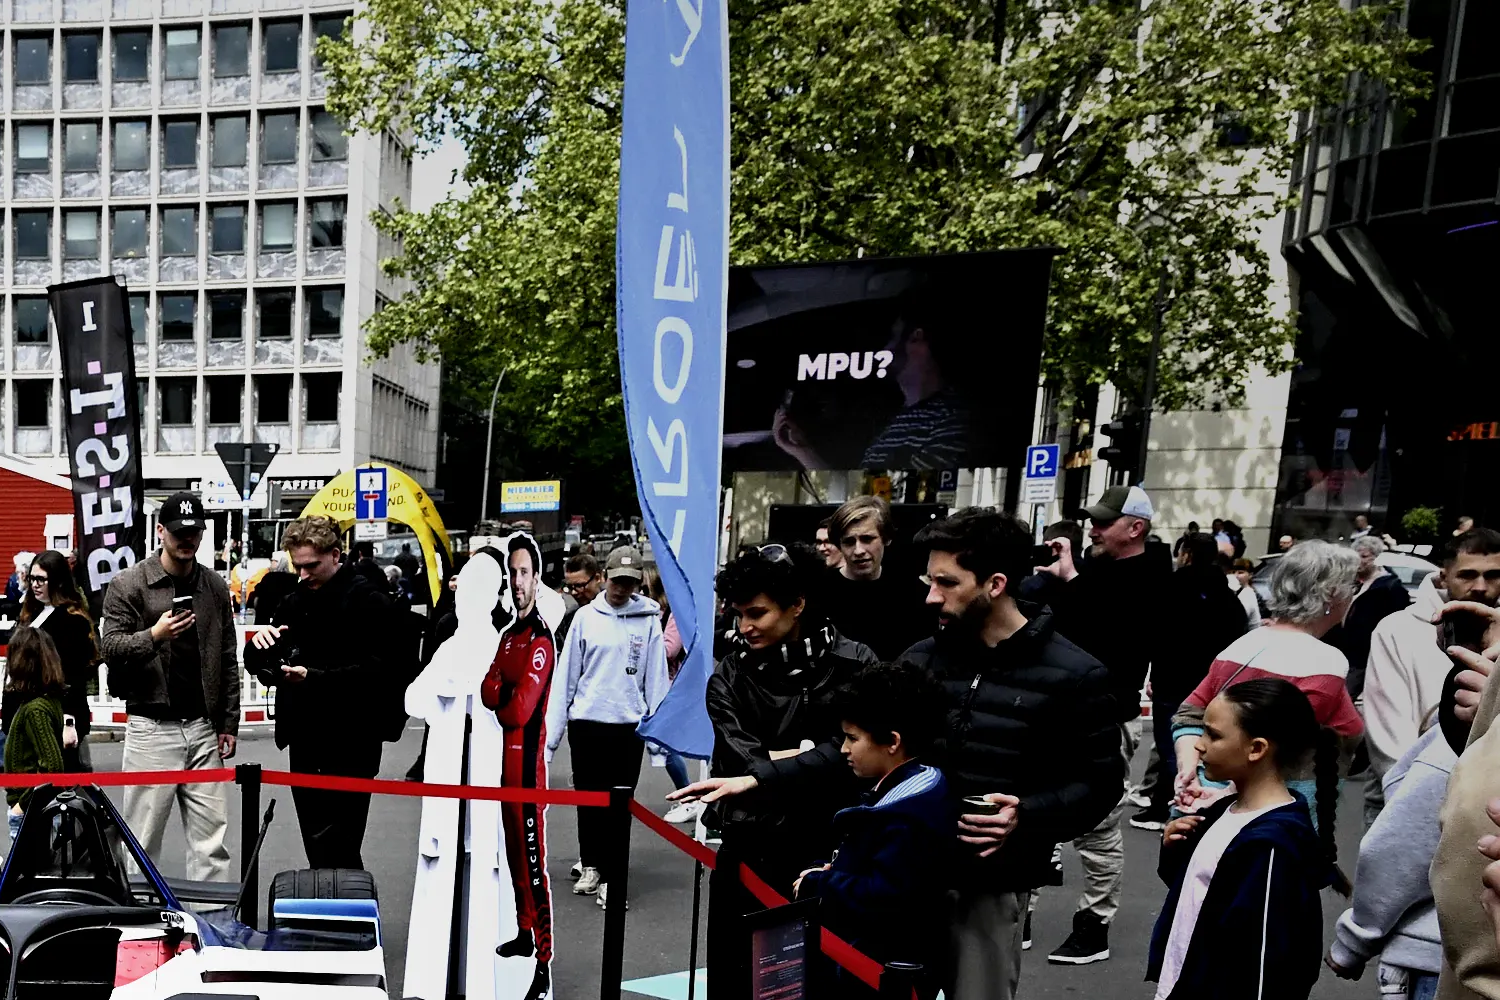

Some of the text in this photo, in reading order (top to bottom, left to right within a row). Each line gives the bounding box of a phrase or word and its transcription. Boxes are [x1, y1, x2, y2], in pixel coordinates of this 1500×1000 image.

[797, 350, 893, 381] MPU?
[507, 485, 555, 494] NIEMEIER
[323, 501, 357, 512] YOUR
[526, 817, 541, 886] RACING
